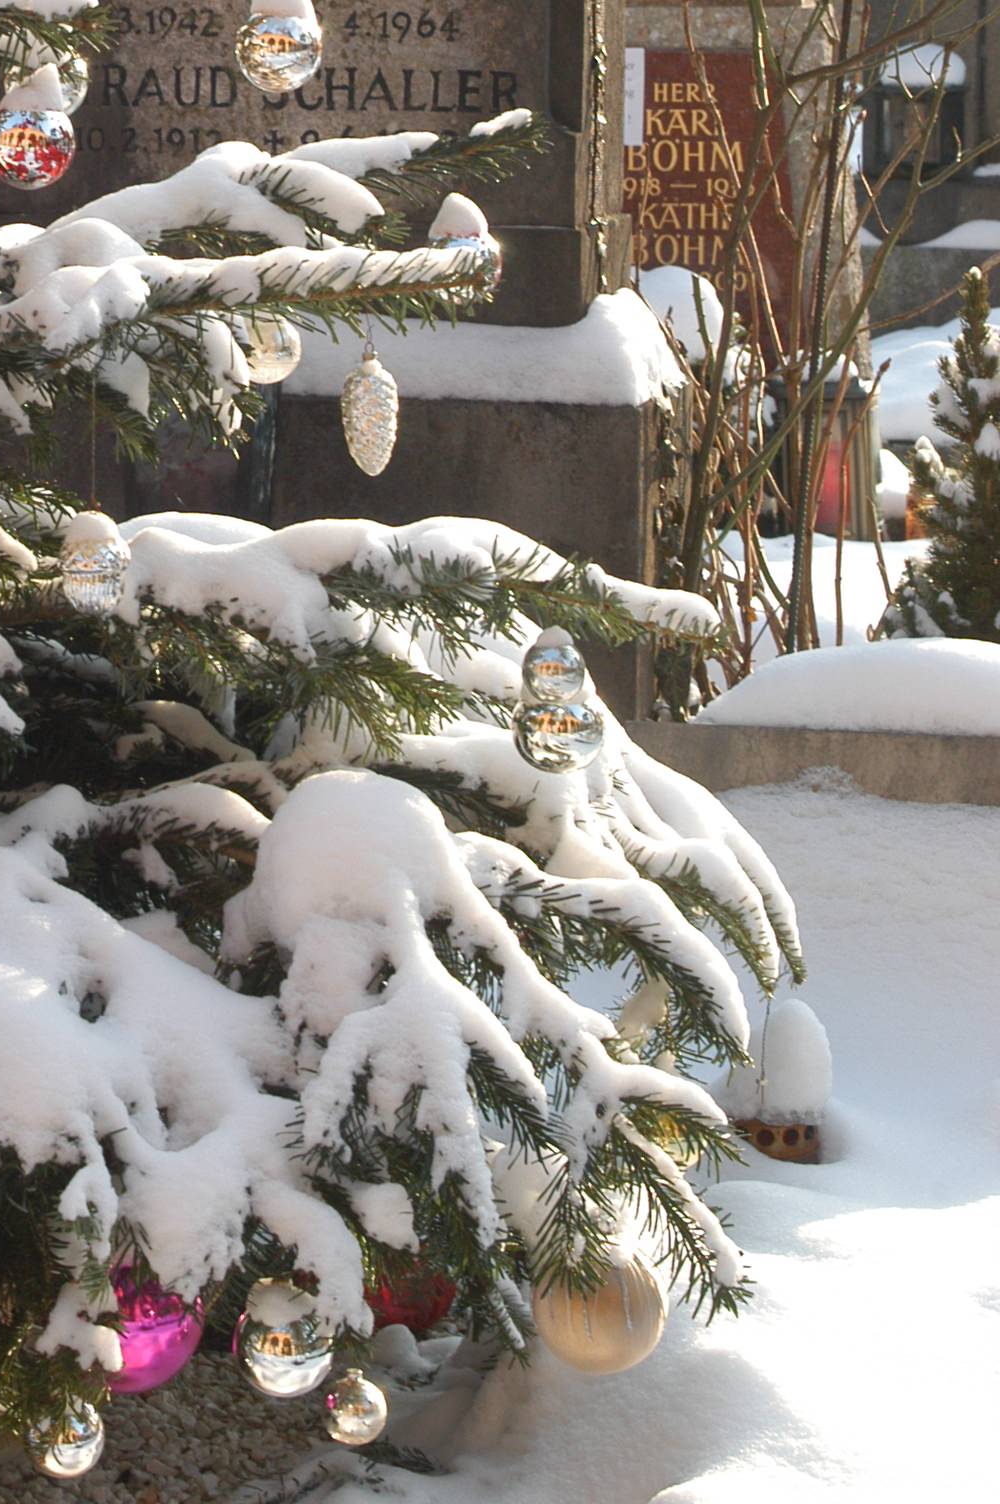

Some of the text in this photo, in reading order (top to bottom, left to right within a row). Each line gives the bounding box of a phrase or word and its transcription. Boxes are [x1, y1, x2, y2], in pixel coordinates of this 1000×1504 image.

[98, 62, 238, 109] RAUD
[653, 82, 718, 104] HERR
[626, 137, 745, 173] BÖHM
[622, 176, 661, 200] 918
